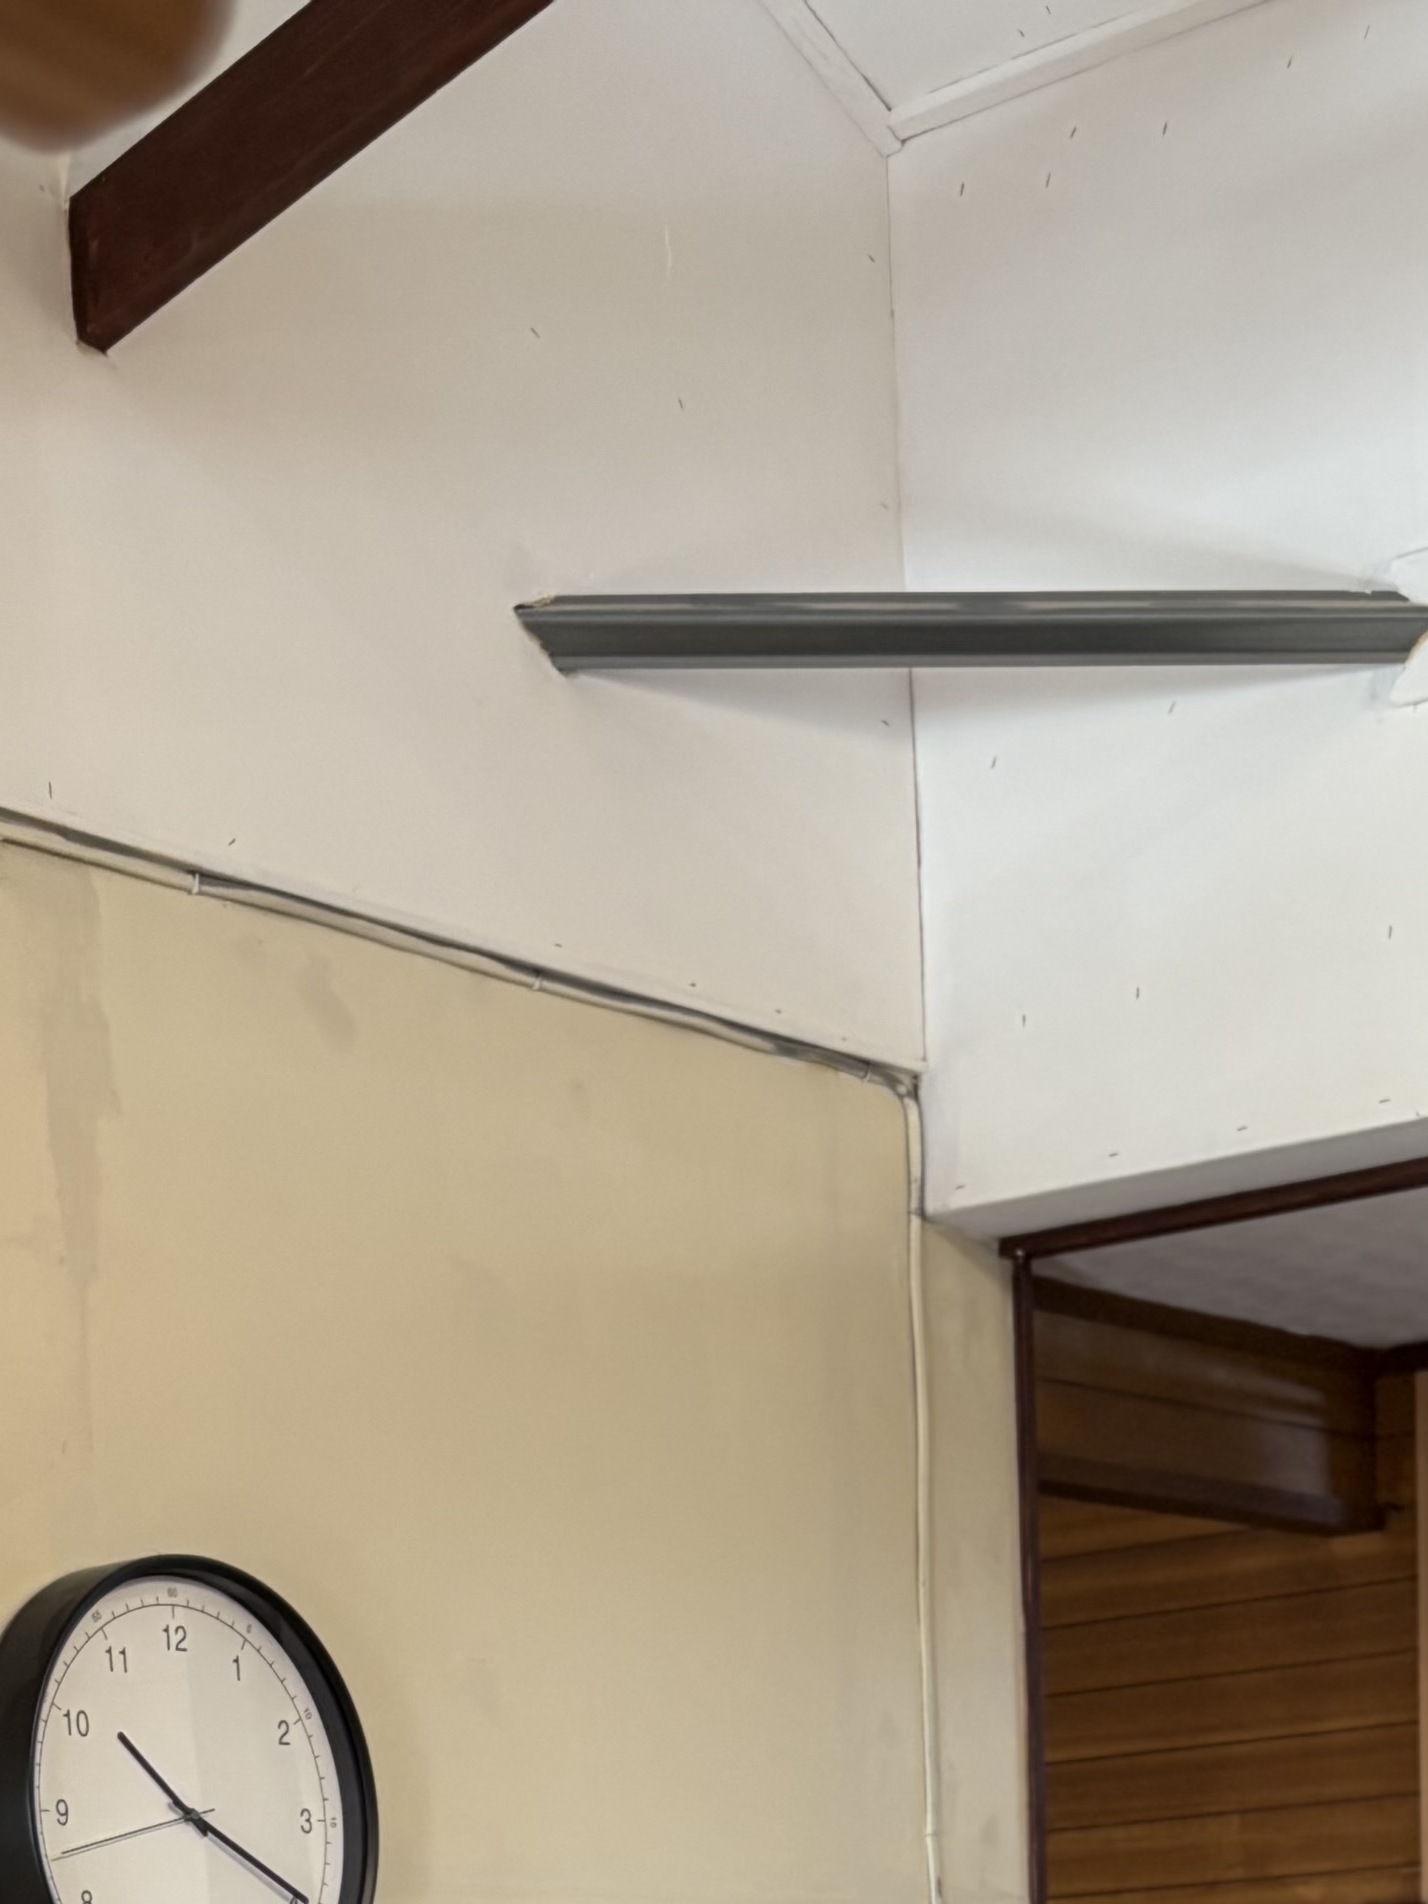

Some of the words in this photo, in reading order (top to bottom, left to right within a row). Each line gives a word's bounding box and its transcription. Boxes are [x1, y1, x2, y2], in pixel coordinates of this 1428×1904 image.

[162, 1624, 188, 1652] 12
[105, 1646, 128, 1674] 11
[232, 1655, 241, 1681] 1
[63, 1709, 90, 1737] 10
[277, 1719, 291, 1746] 2
[55, 1799, 69, 1826] 9
[300, 1808, 313, 1834] 3
